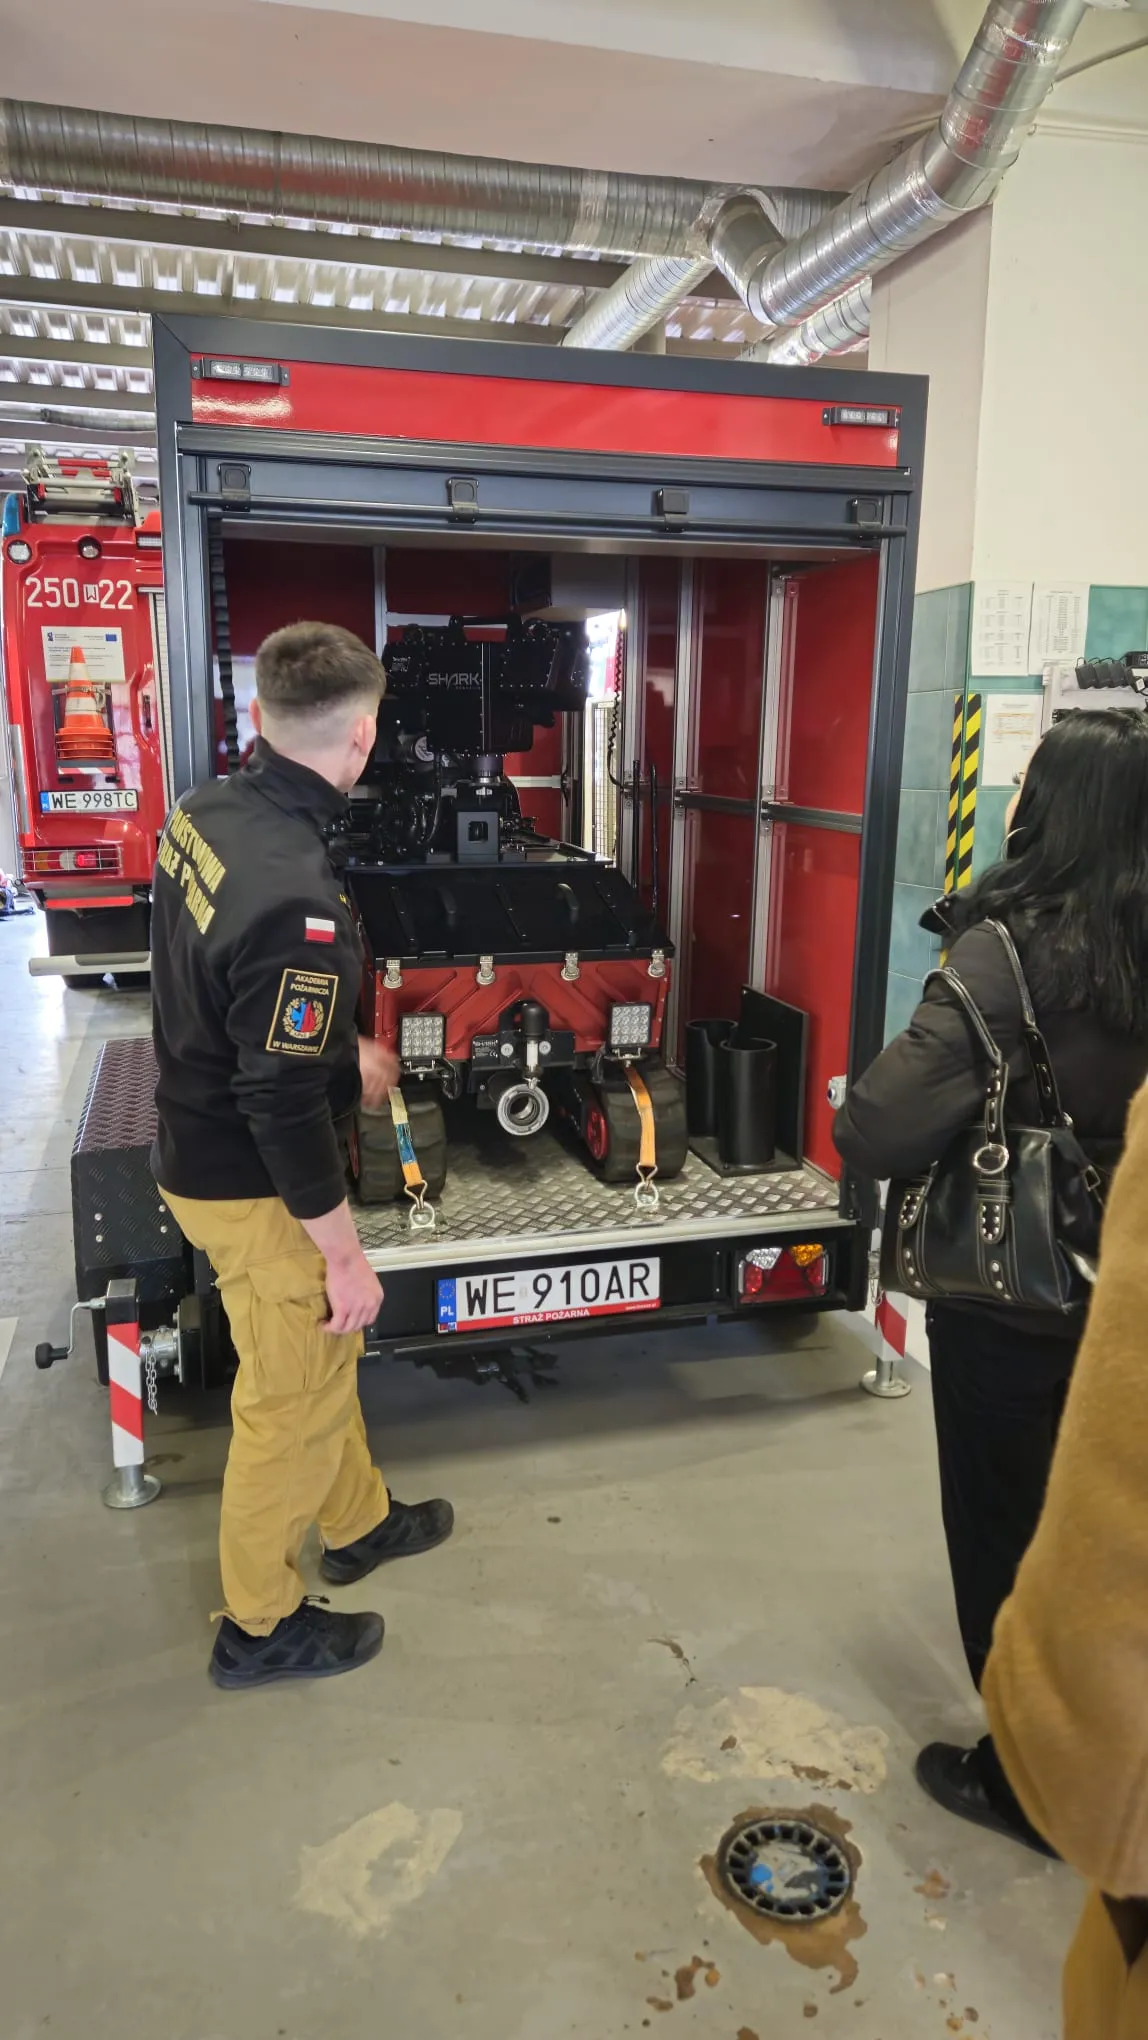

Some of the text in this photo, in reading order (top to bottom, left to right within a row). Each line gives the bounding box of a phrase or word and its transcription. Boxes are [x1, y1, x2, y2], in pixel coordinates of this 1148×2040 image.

[25, 576, 134, 610] 250 W 22
[429, 672, 480, 689] SHARK
[51, 793, 77, 809] WE
[82, 792, 135, 808] 998TC
[466, 1262, 650, 1317] WE 910AR
[440, 1305, 455, 1317] PL
[512, 1308, 591, 1325] STRAŻ POŻARNA
